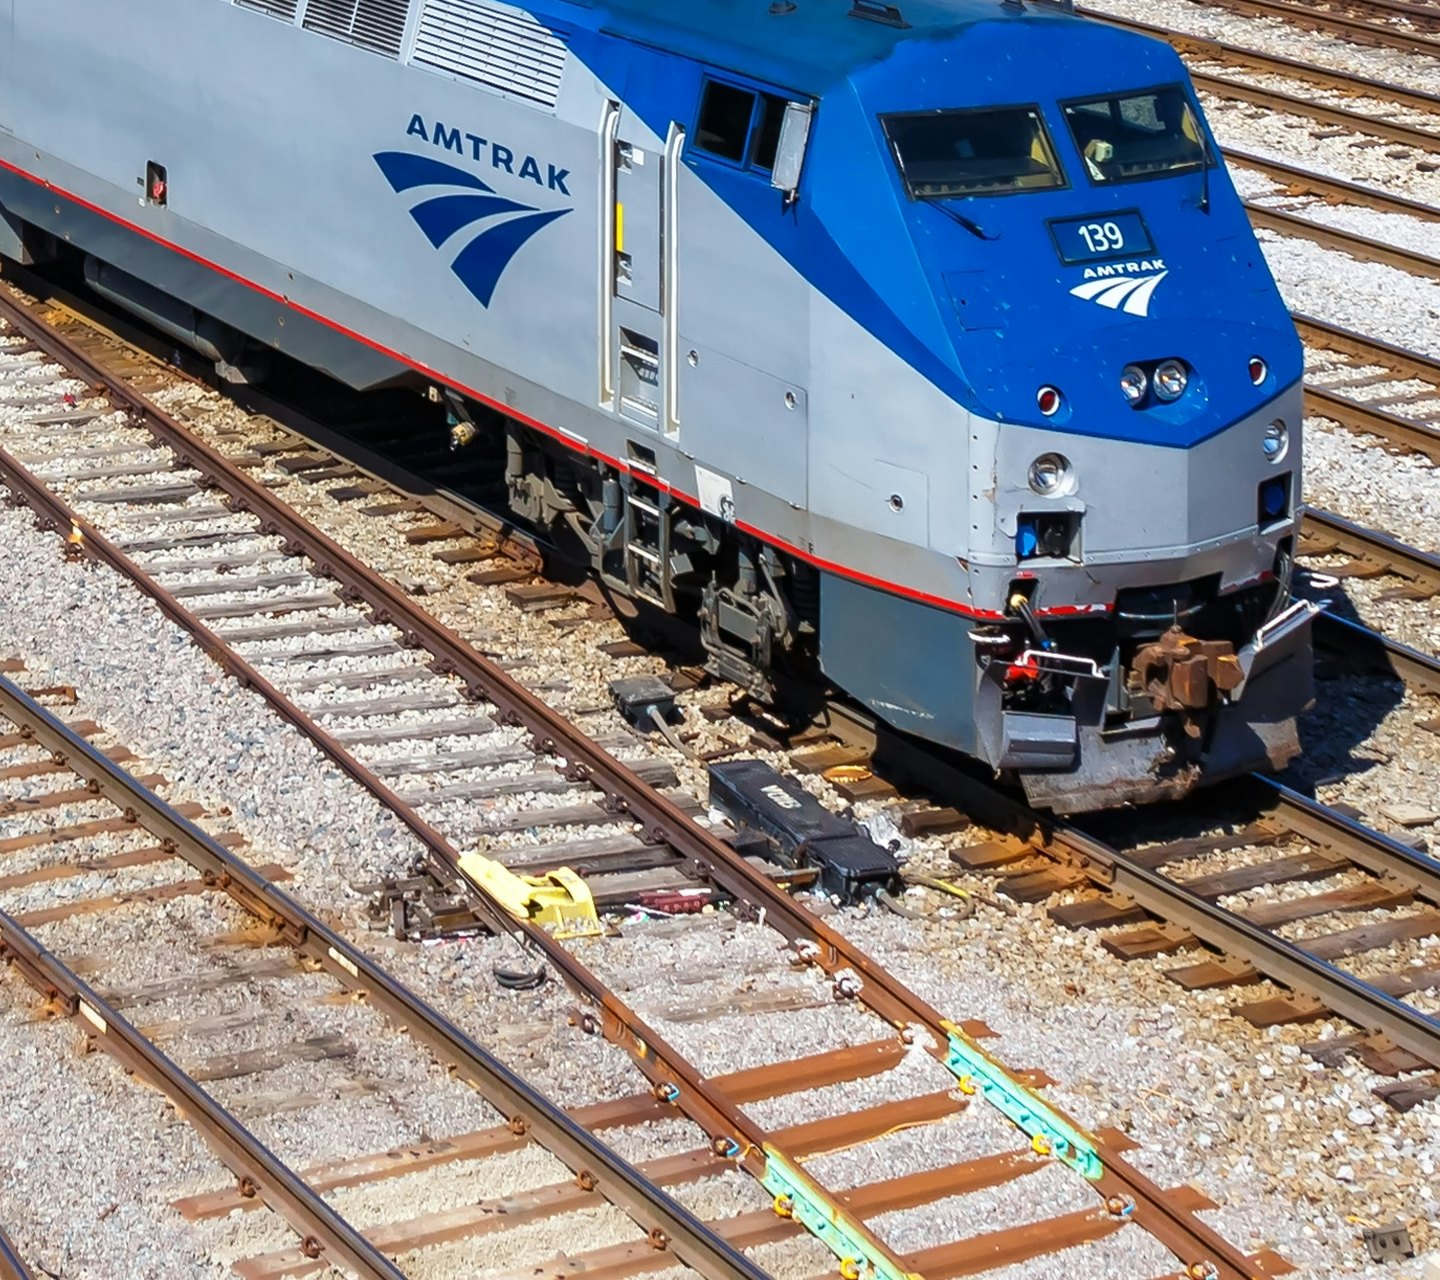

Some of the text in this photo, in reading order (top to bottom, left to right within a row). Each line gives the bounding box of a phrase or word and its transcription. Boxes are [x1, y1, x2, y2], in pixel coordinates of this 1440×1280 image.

[406, 113, 572, 197] AMTRAK
[1078, 221, 1124, 253] 139
[1083, 258, 1166, 280] AMTRAK
